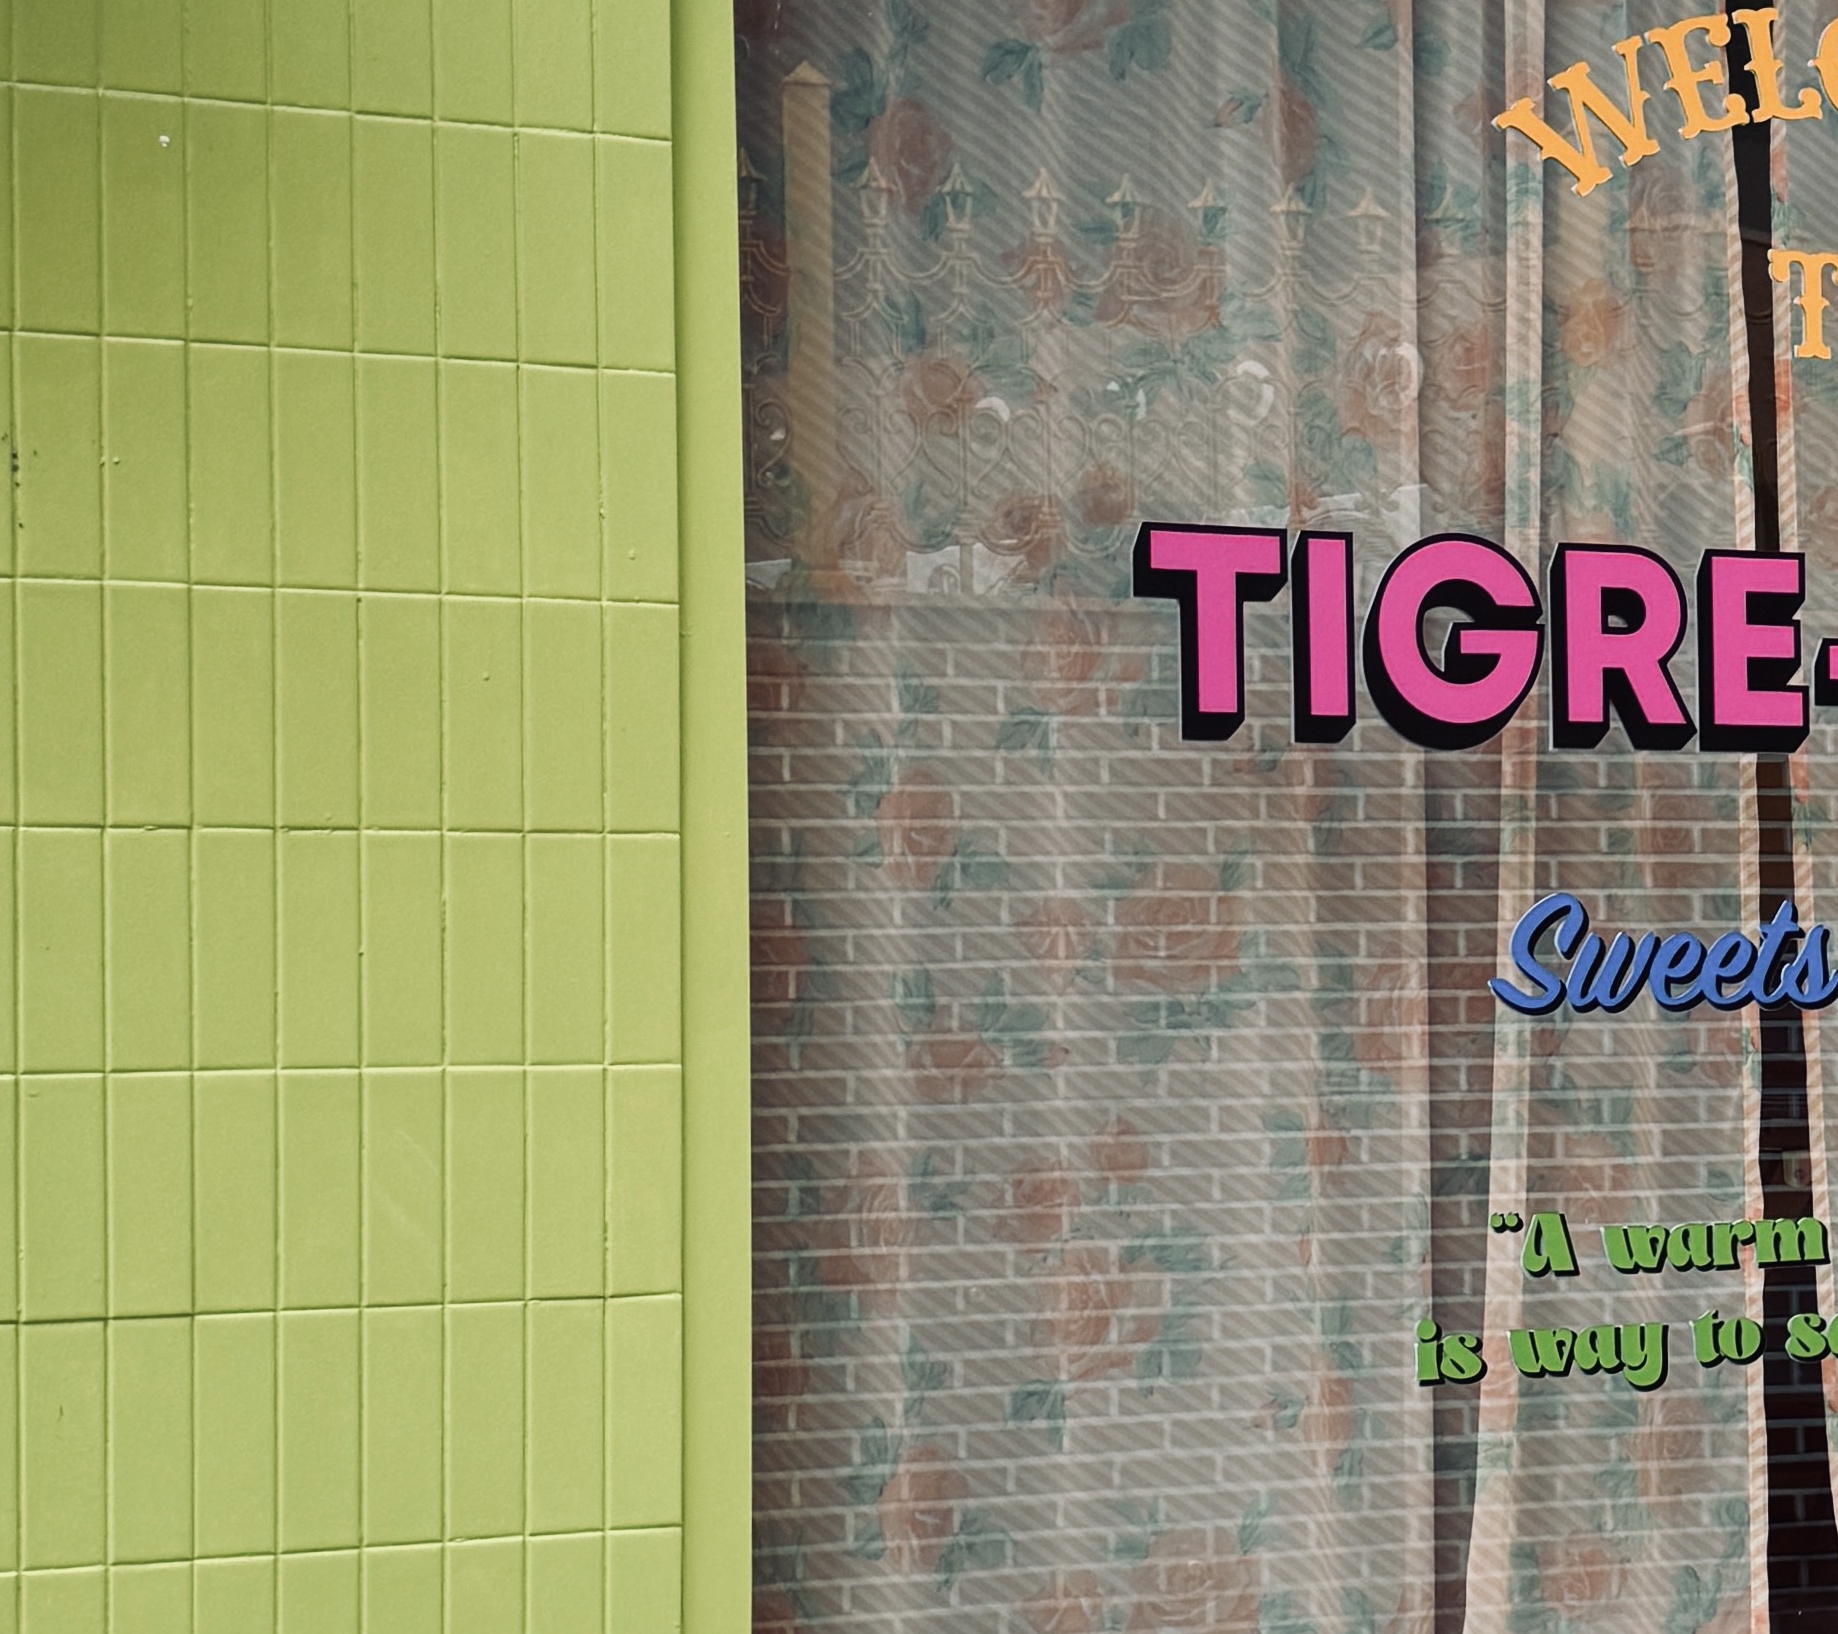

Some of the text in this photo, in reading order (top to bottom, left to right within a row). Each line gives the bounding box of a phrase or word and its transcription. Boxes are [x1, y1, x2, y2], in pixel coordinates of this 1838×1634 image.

[1600, 1215, 1831, 1275] warm
[1414, 1317, 1488, 1387] is
[1506, 1321, 1670, 1393] way
[1689, 1308, 1767, 1369] to
